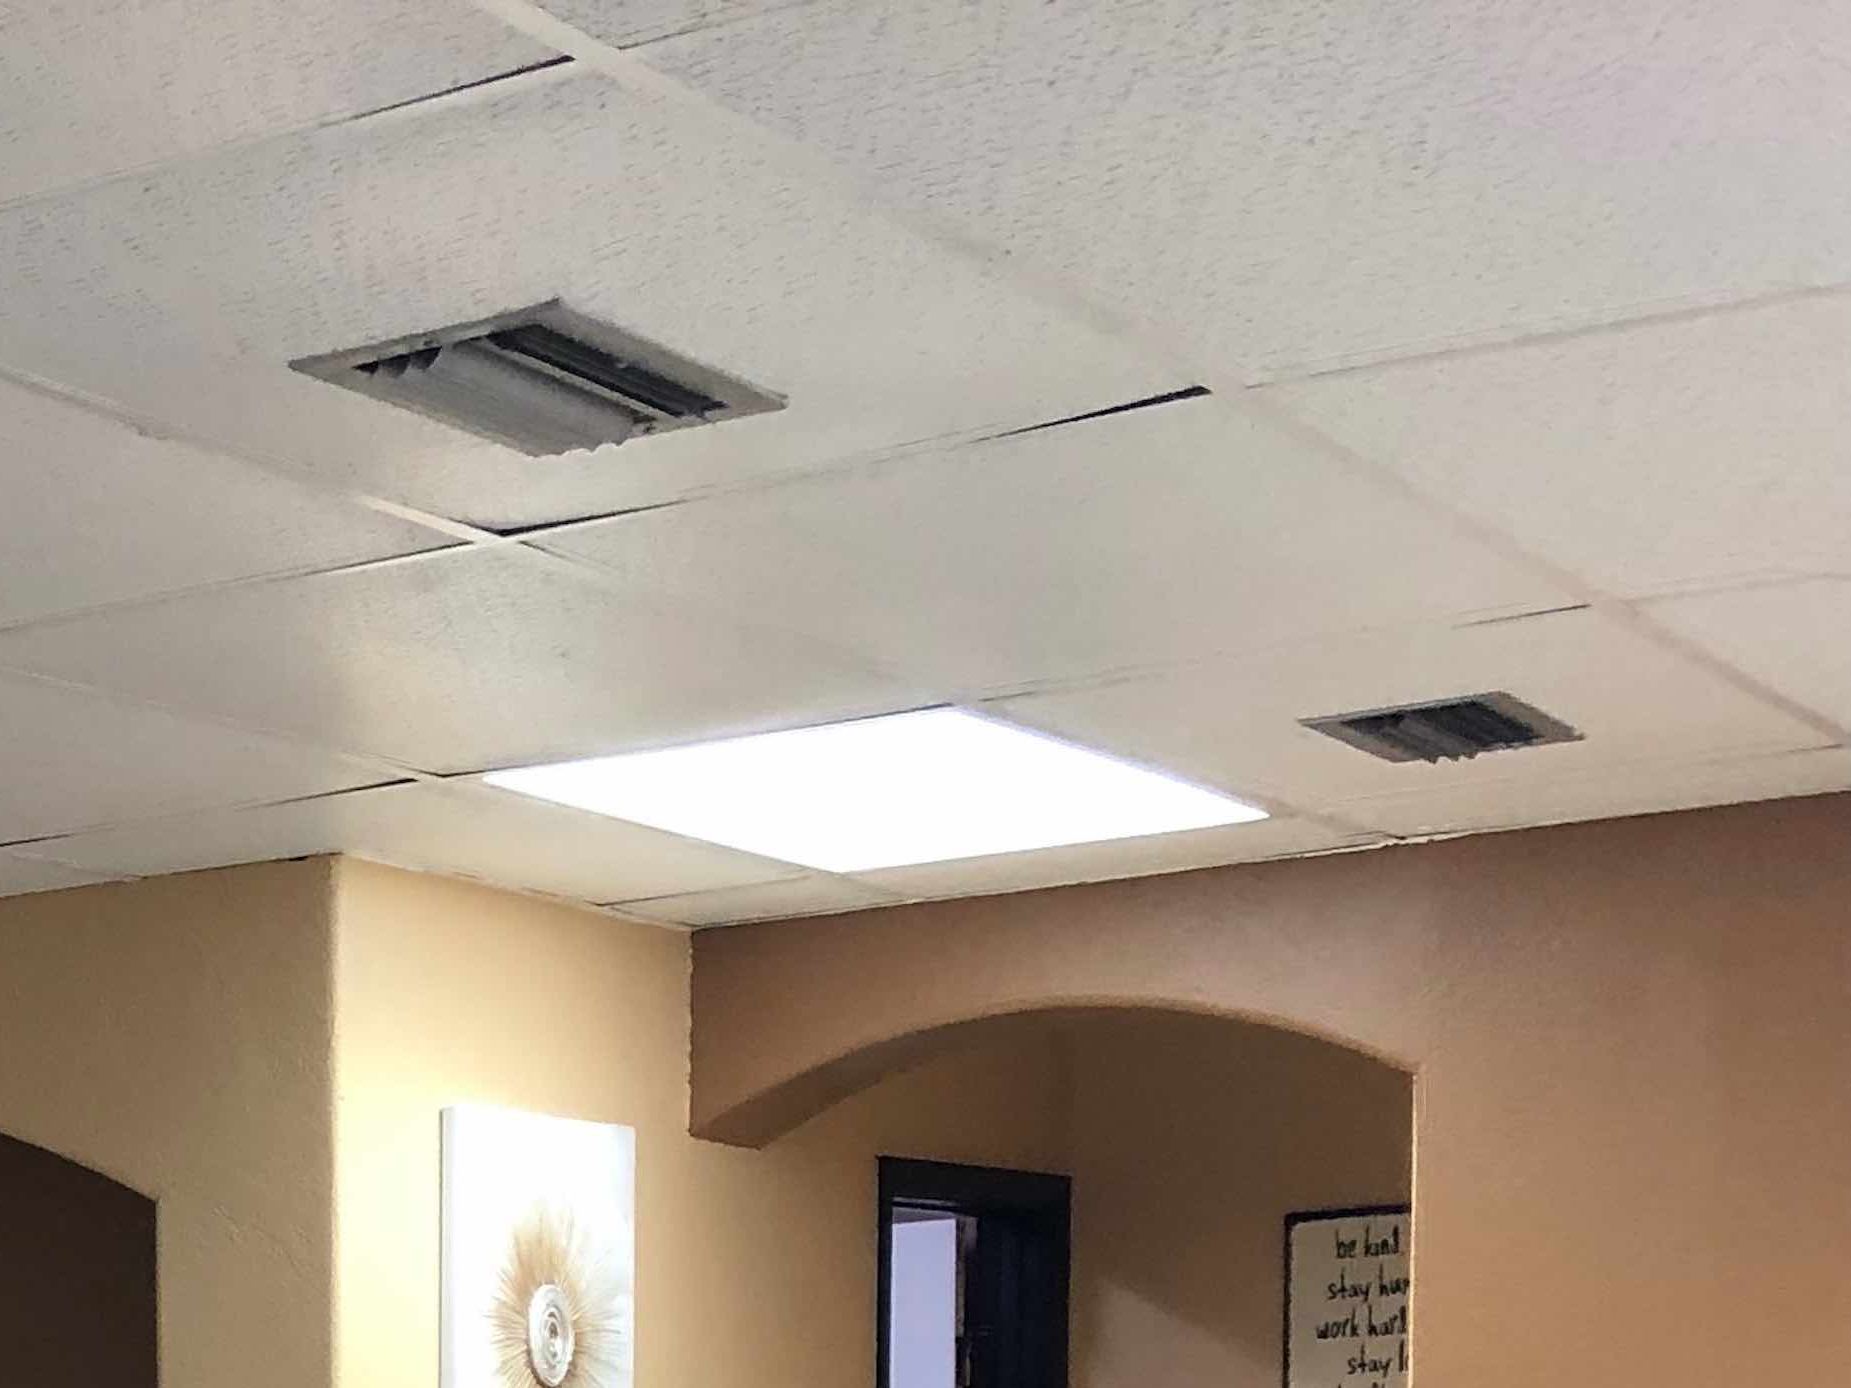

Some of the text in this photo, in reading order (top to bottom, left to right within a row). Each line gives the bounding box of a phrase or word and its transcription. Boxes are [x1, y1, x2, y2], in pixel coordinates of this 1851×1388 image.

[1335, 1225, 1400, 1258] be kind
[1325, 1266, 1371, 1302] stay
[1316, 1303, 1407, 1339] work hard
[1347, 1339, 1409, 1378] stay l
